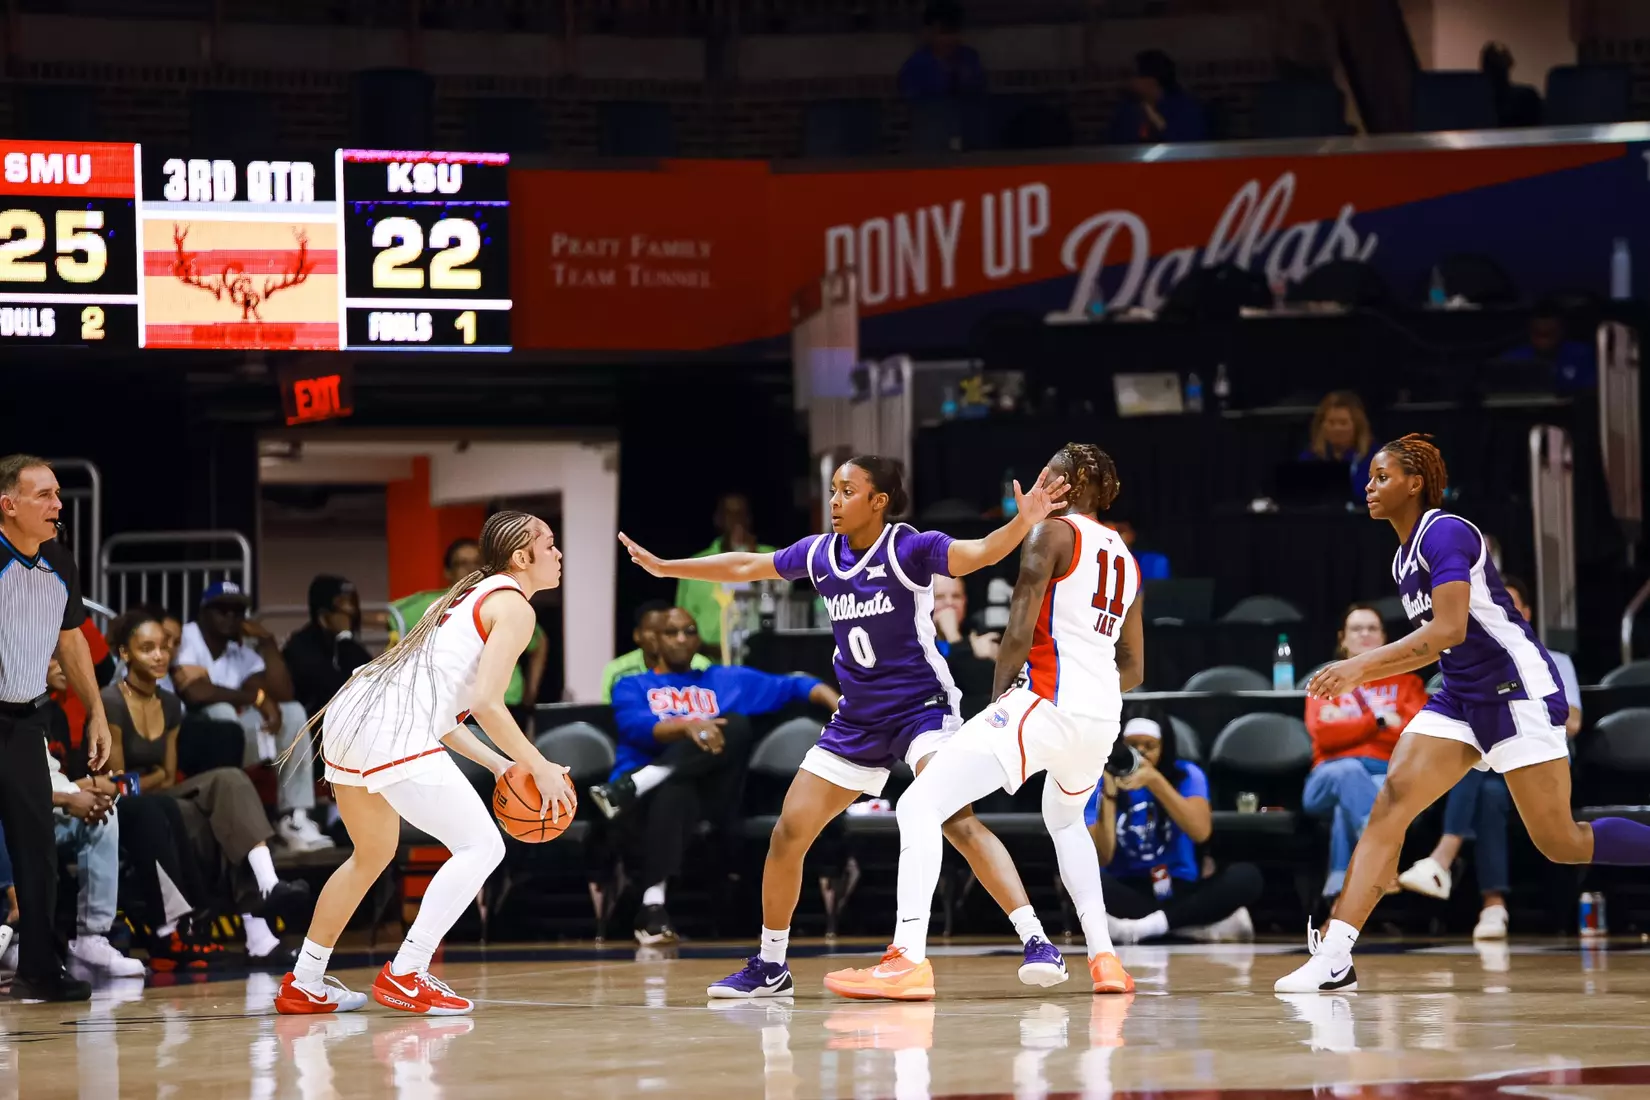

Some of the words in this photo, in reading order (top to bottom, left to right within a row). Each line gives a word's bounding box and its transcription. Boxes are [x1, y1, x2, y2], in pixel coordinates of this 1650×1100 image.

[4, 152, 92, 185] SMU
[163, 158, 237, 202] 3RD
[247, 160, 316, 203] QTR
[387, 162, 463, 194] KSU
[0, 208, 108, 284] 25
[372, 216, 482, 290] 22
[981, 181, 1052, 280] UP
[1050, 170, 1379, 322] Dallas
[0, 307, 56, 338] OULS
[81, 306, 105, 340] 2
[454, 310, 477, 344] 1
[295, 375, 341, 418] EXIT
[1091, 548, 1126, 618] 11
[823, 589, 895, 621] Wildcats
[848, 626, 877, 669] 0
[647, 686, 720, 717] SMU
